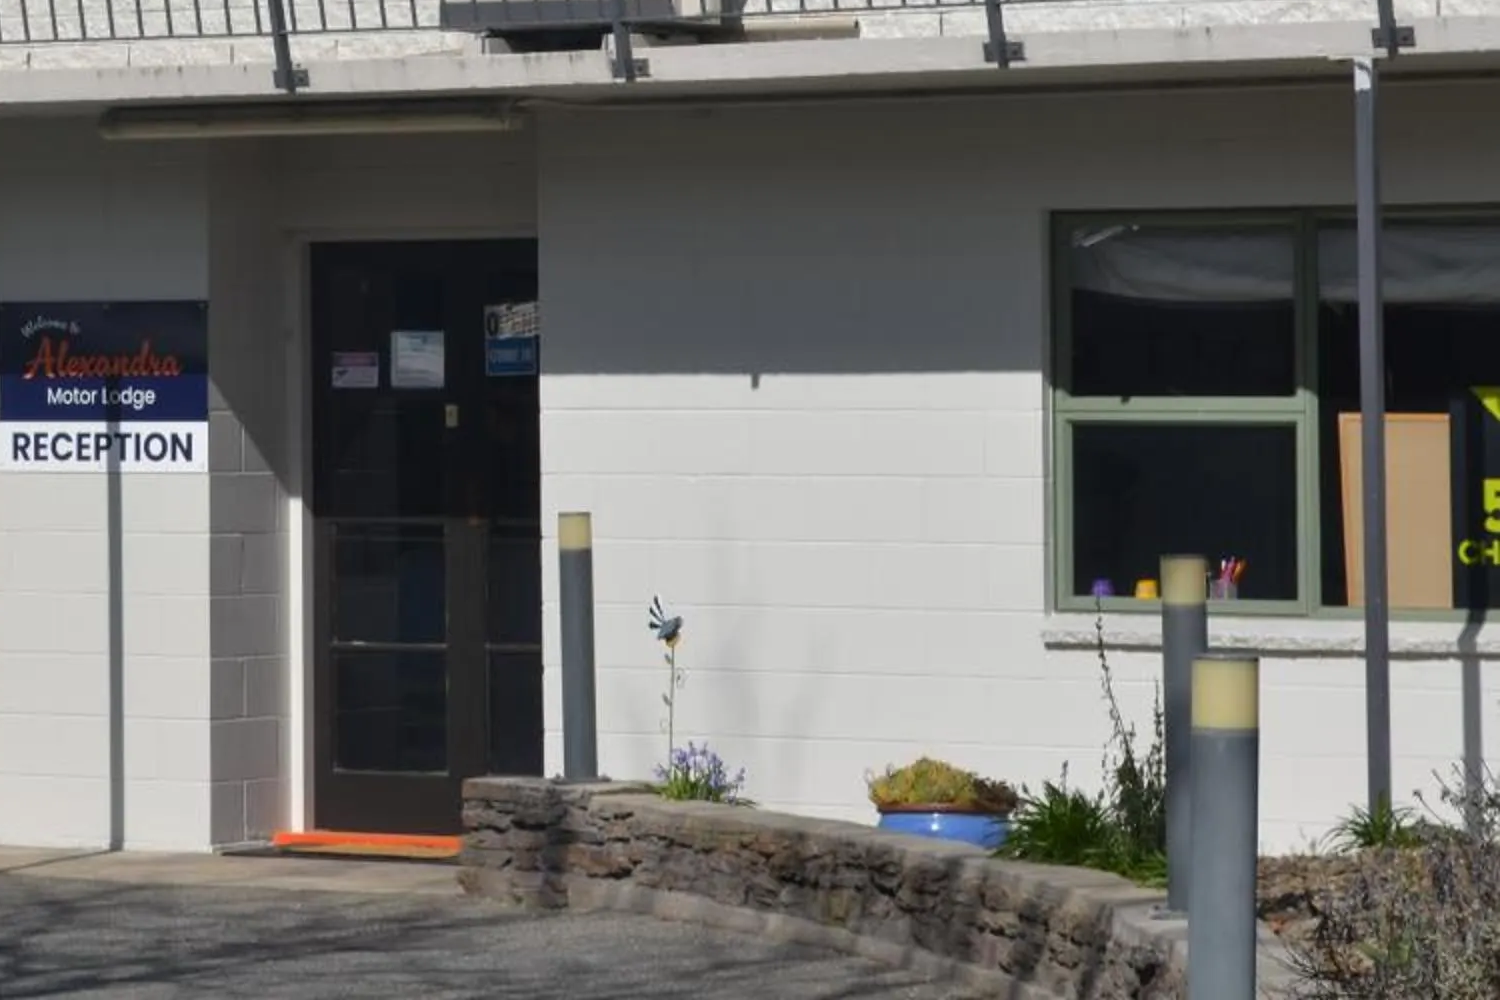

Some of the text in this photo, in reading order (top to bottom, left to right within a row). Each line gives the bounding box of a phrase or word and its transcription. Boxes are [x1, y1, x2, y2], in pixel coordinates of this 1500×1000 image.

[22, 335, 183, 380] Alexandra
[47, 386, 156, 409] Motor Lodge
[12, 432, 193, 461] RECEPTION
